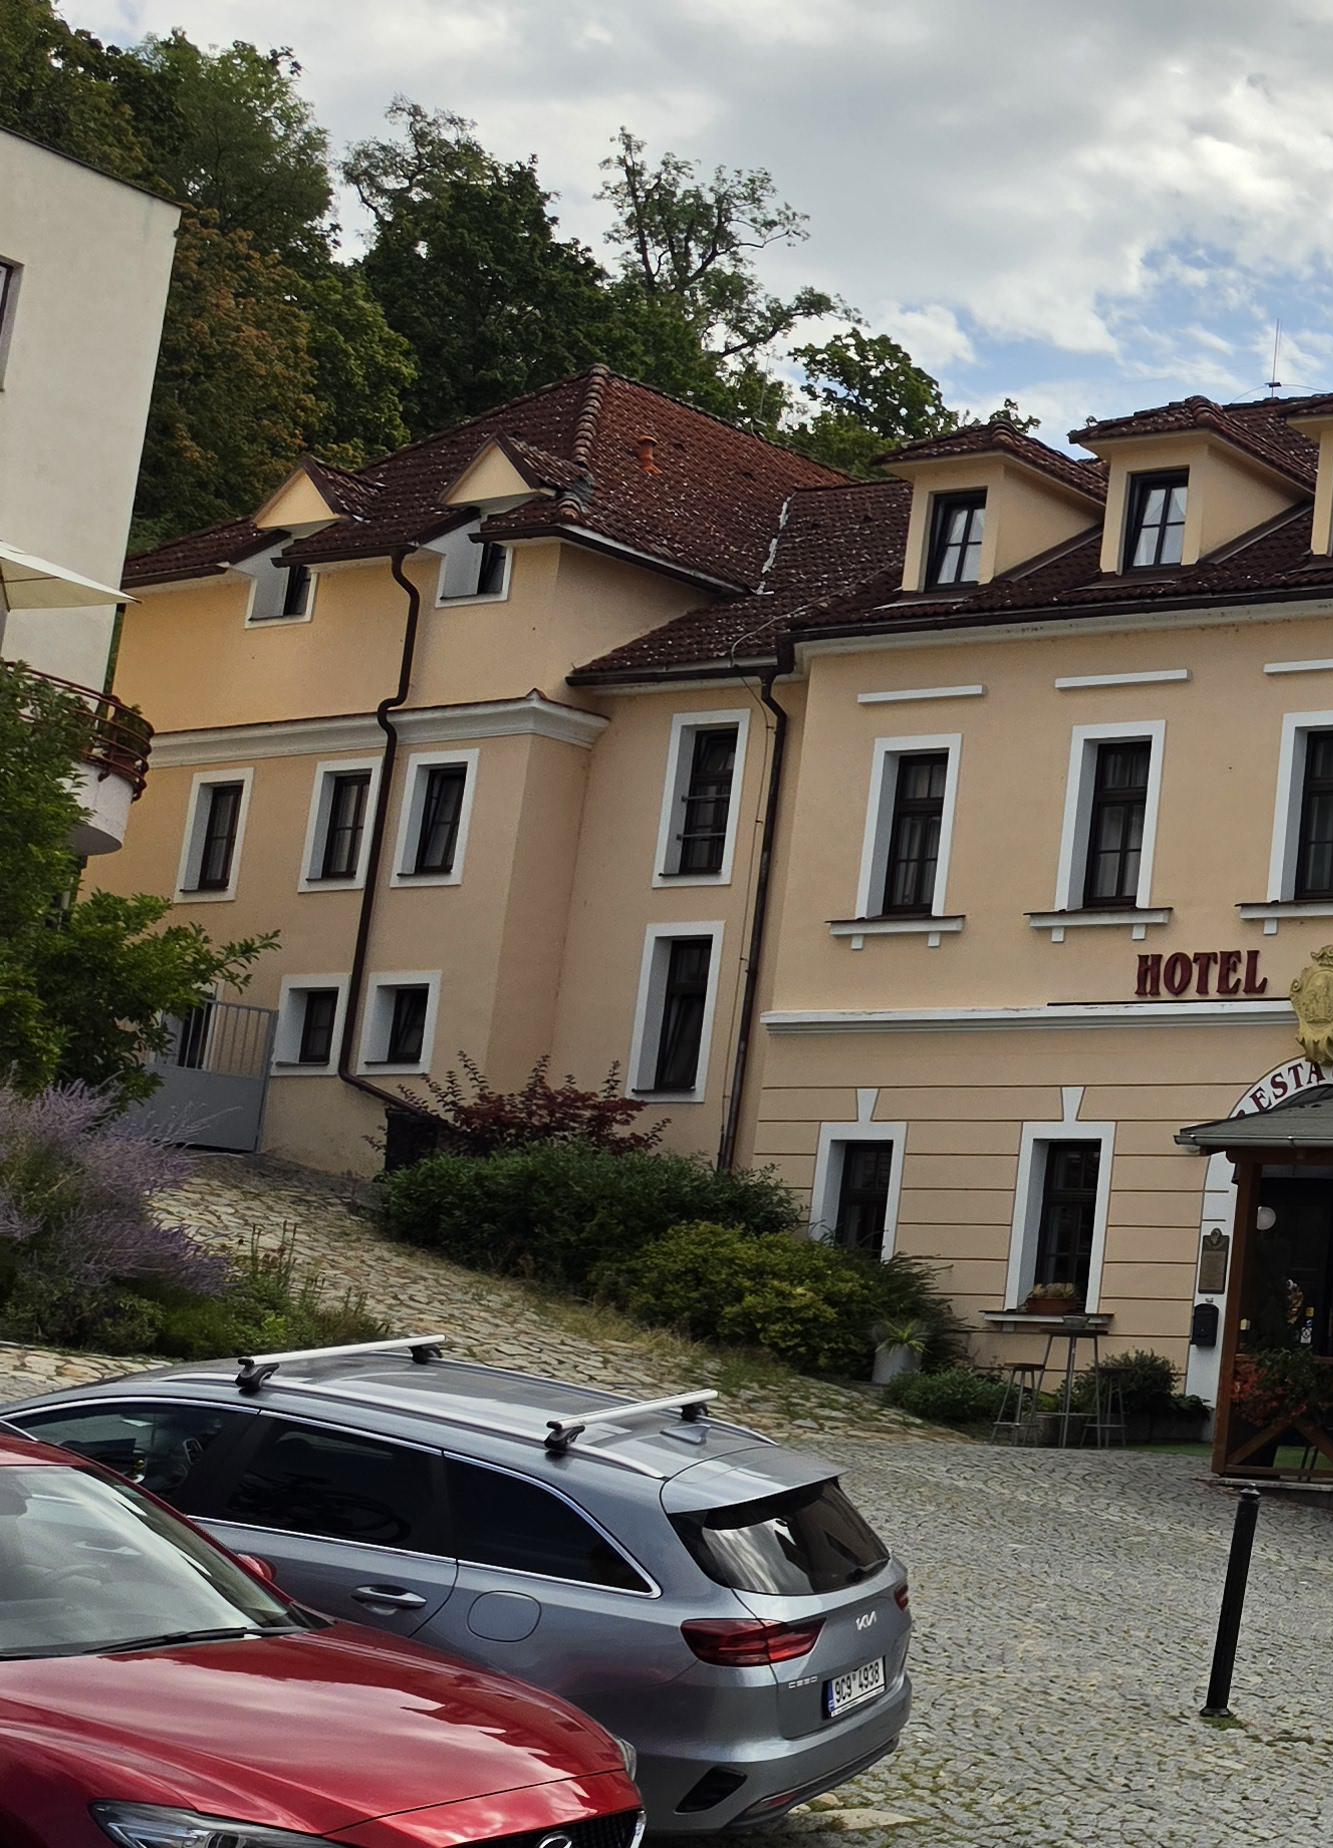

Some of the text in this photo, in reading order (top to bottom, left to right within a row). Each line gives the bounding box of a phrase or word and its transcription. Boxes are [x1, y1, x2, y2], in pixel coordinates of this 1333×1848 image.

[1135, 949, 1267, 996] HOTEL
[834, 1661, 880, 1703] 9C9 4938
